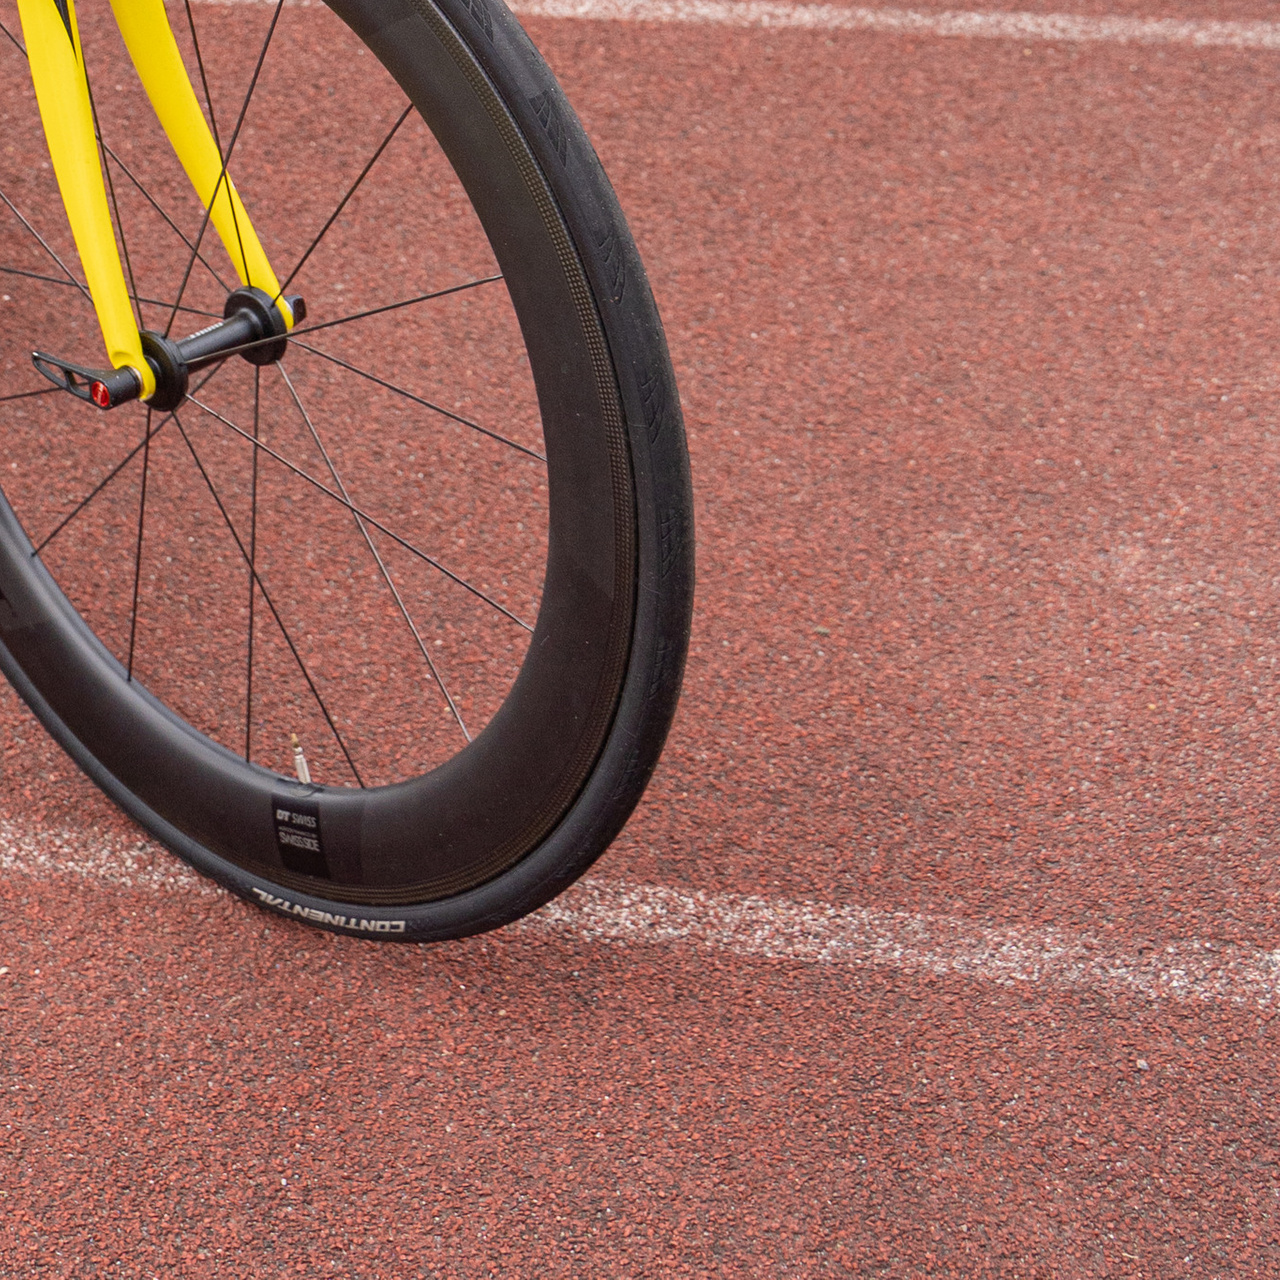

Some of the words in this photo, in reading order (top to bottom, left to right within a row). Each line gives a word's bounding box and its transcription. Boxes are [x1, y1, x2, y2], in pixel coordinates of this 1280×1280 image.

[275, 808, 291, 823] DT
[292, 812, 317, 828] SWISS
[252, 887, 406, 933] CONTINENTAL
